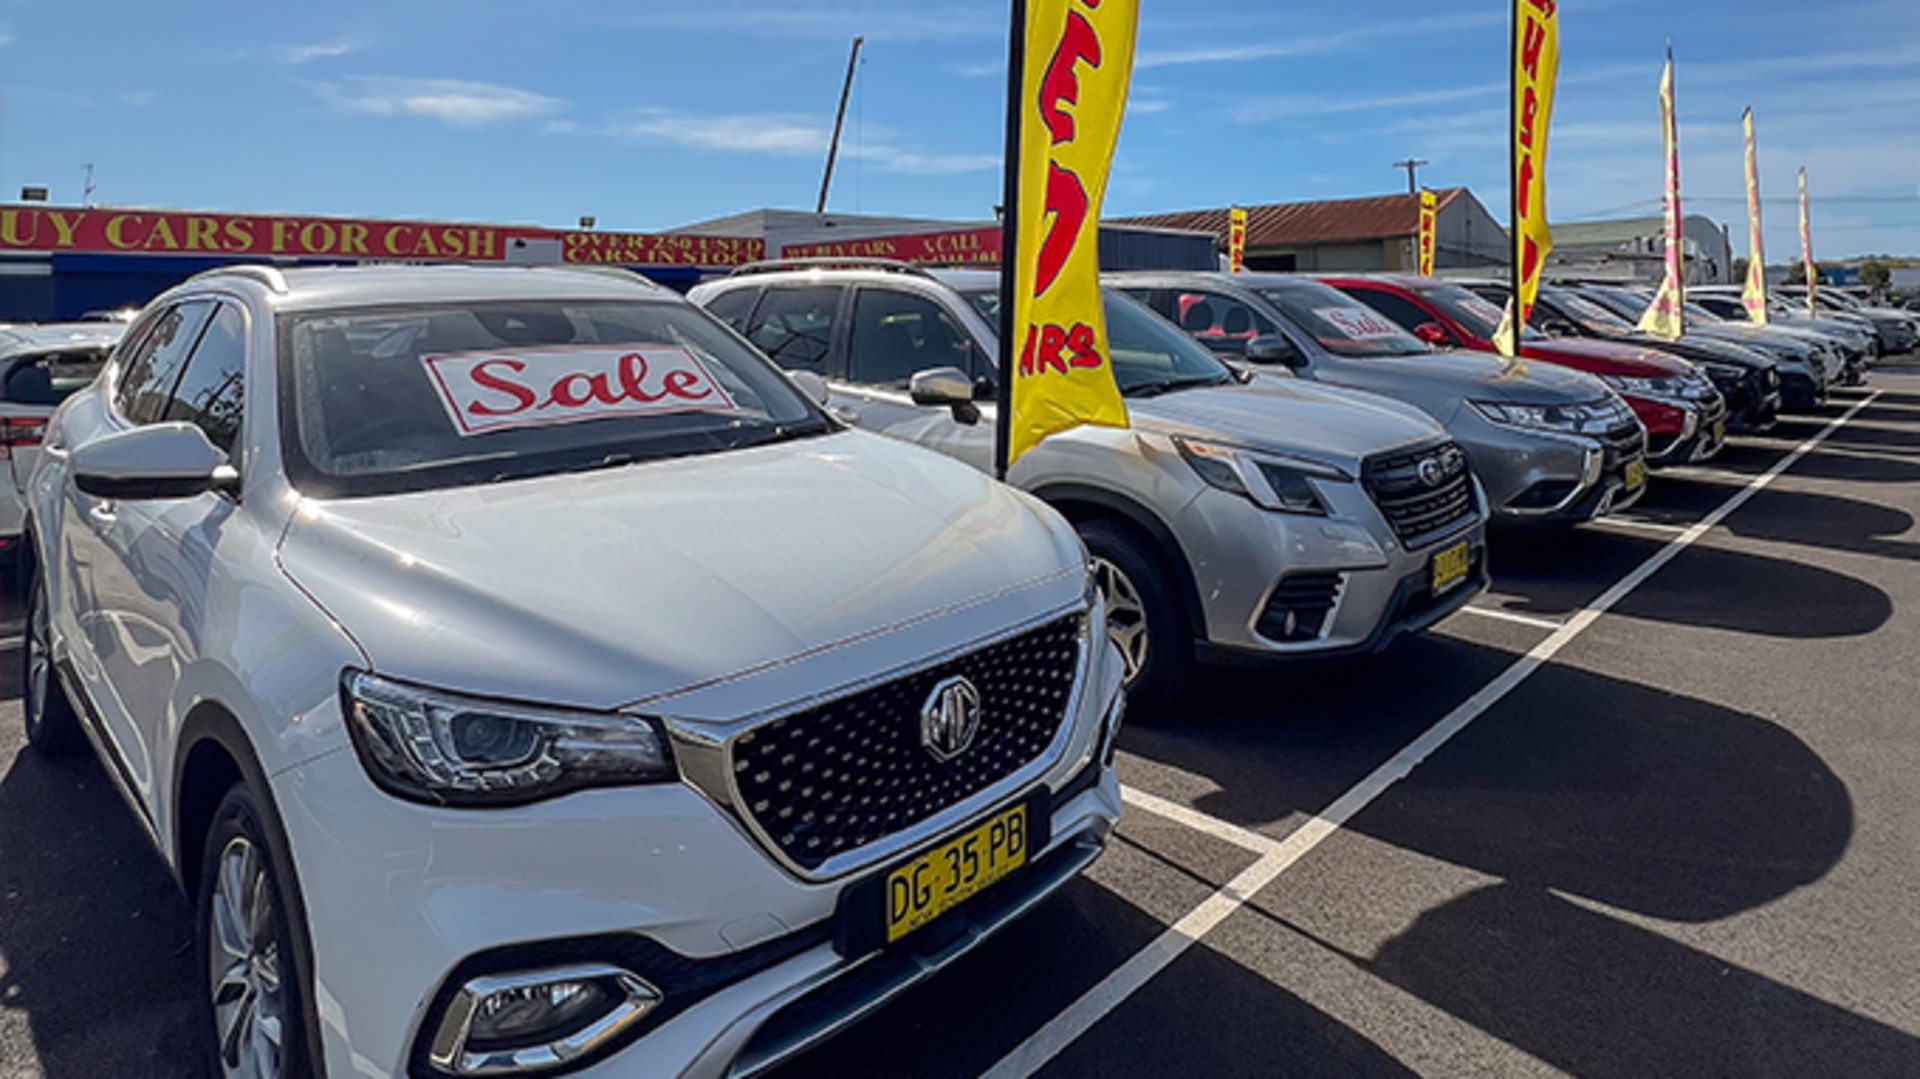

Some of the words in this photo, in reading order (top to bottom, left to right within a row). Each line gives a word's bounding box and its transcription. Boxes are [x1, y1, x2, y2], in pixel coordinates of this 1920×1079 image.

[0, 210, 87, 247] UY
[105, 213, 255, 251] CARS
[270, 220, 369, 254] FOR
[384, 225, 496, 257] CASH
[565, 233, 646, 249] OVER
[654, 236, 693, 250] 250
[700, 237, 763, 251] USED
[849, 240, 897, 256] CARS
[566, 249, 640, 264] CARS
[649, 250, 675, 264] IN
[467, 352, 713, 416] Sale
[926, 679, 980, 755] MG
